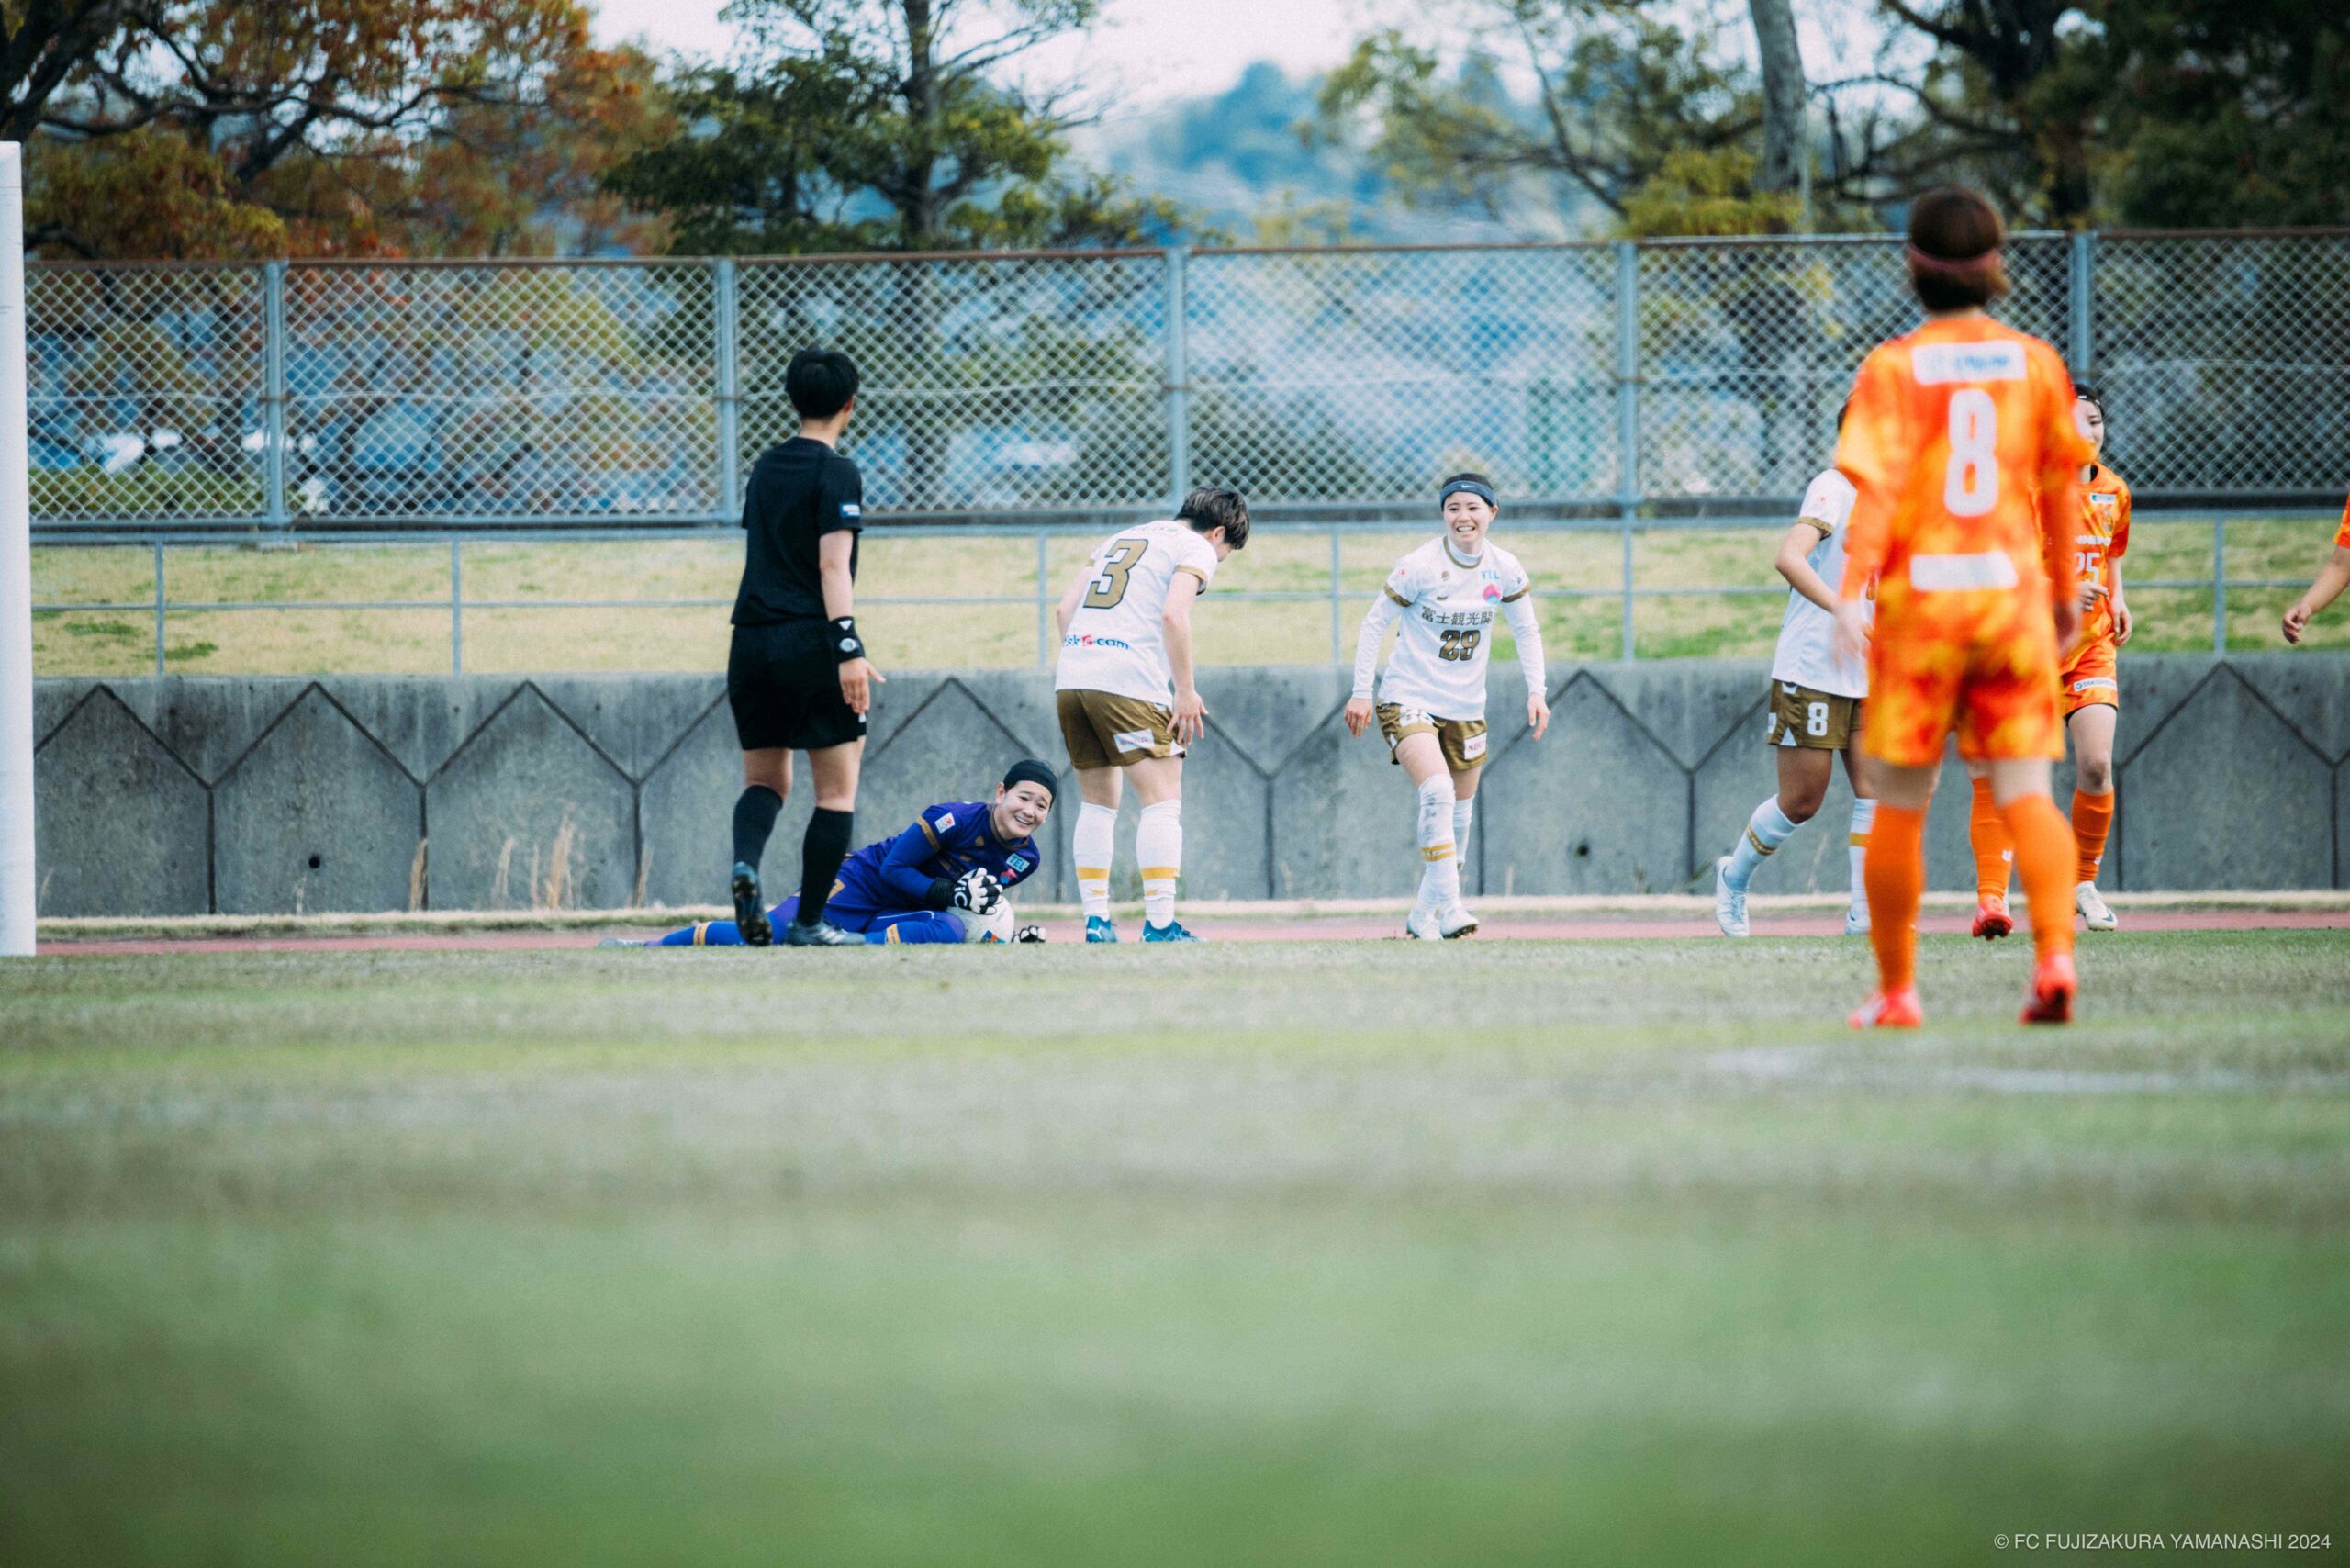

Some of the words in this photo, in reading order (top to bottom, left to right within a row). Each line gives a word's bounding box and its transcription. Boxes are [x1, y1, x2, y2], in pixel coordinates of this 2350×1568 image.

[1944, 387, 1998, 517] 8
[1083, 539, 1149, 609] 3
[1438, 629, 1481, 661] 29
[1807, 701, 1829, 736] 8
[1010, 854, 1026, 870] TEL
